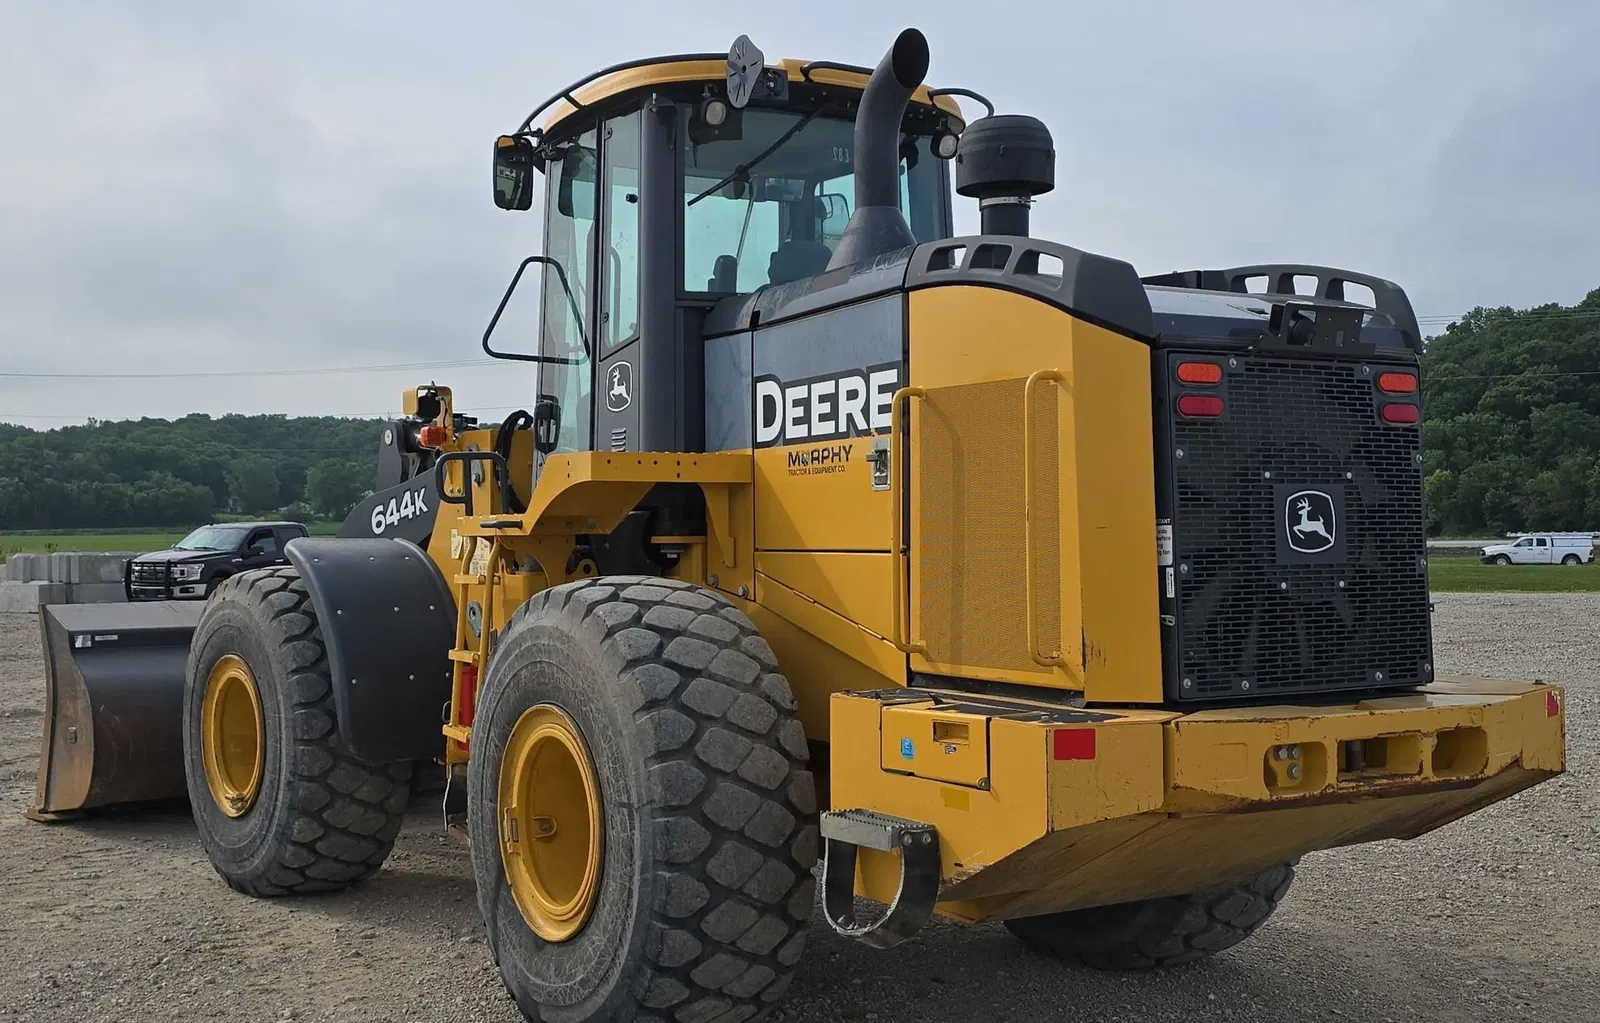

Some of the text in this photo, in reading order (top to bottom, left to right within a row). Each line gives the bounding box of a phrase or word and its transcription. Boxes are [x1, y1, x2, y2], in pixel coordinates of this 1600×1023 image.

[756, 369, 898, 443] DEERE
[788, 468, 807, 476] TRACTOR
[812, 465, 837, 475] EQUIPMENT
[371, 488, 428, 535] 644K
